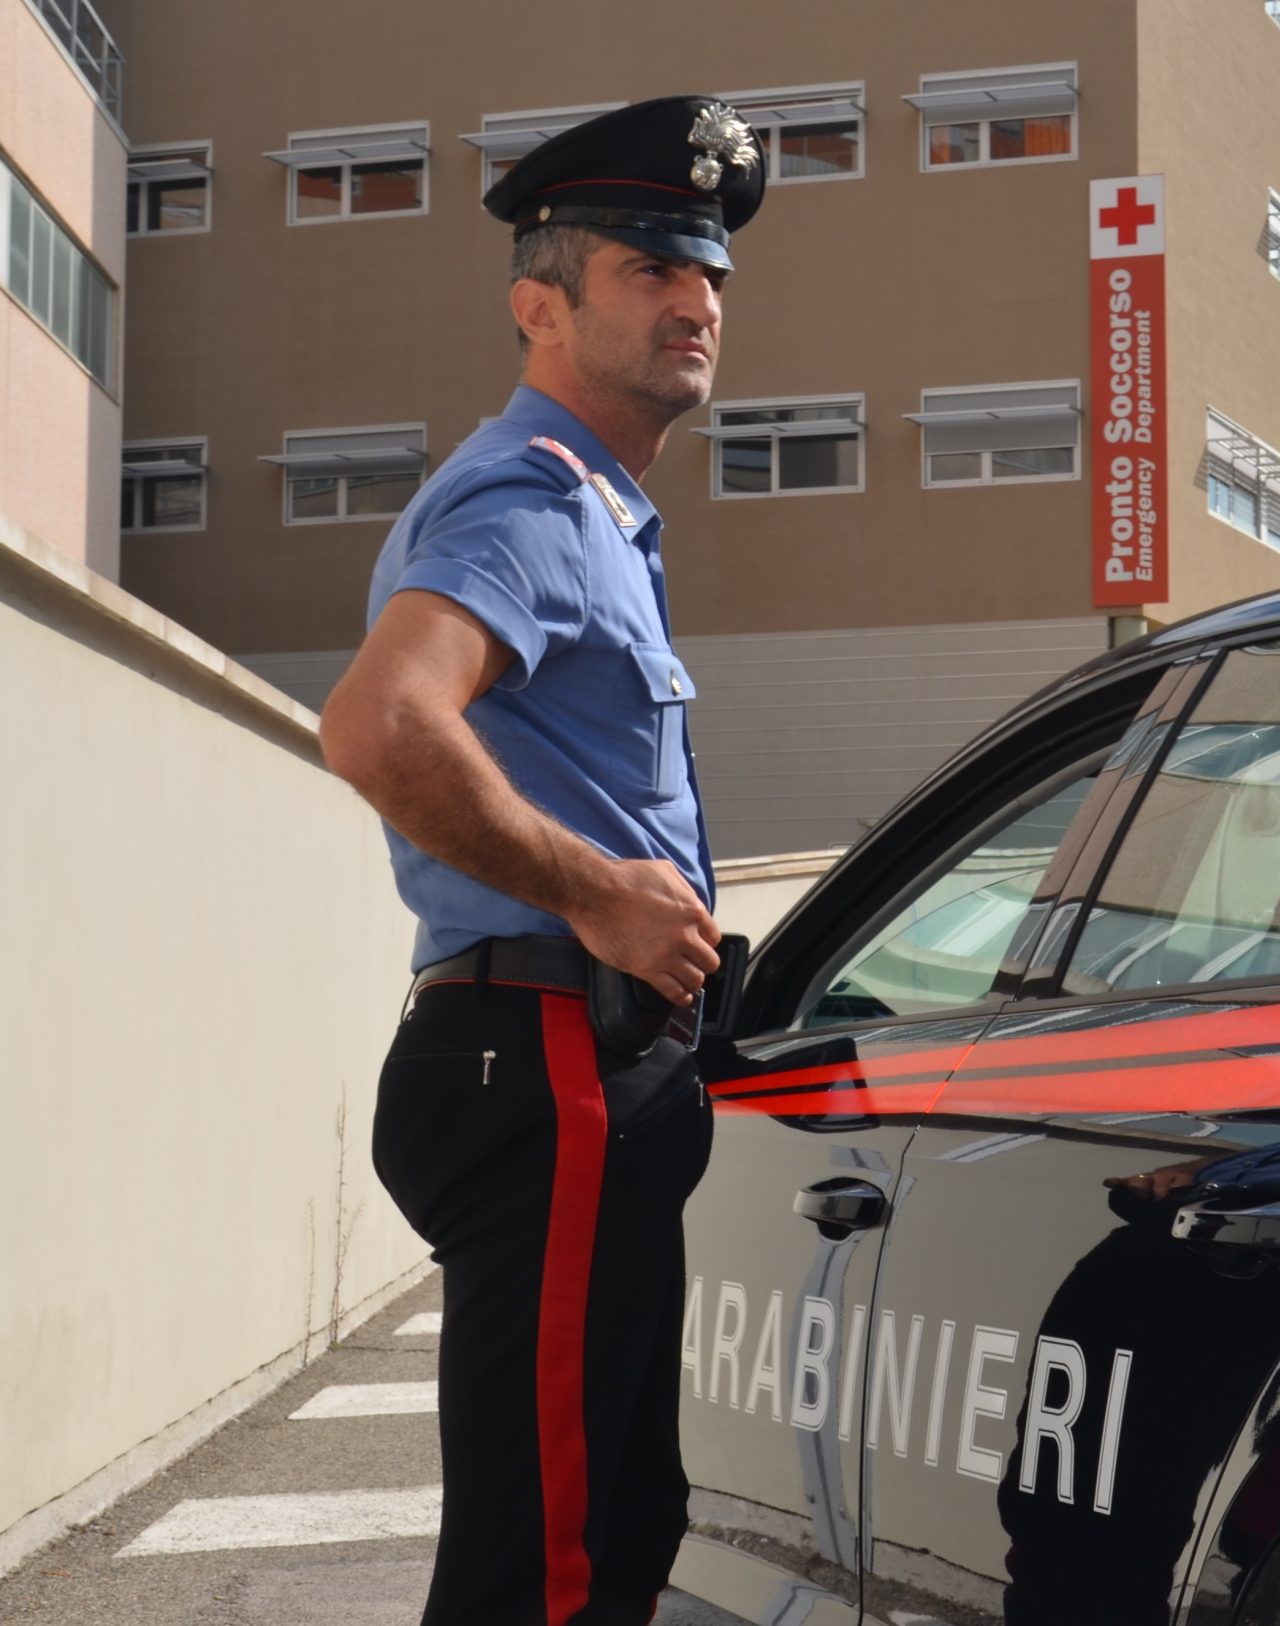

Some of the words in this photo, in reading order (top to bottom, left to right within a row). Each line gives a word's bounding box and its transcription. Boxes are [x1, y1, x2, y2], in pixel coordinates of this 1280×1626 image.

[1104, 269, 1133, 443] Soccorso
[1134, 310, 1155, 443] Department
[1105, 456, 1134, 582] Pronto
[1136, 458, 1156, 581] Emergency
[681, 1276, 1133, 1515] ARABINIERI
